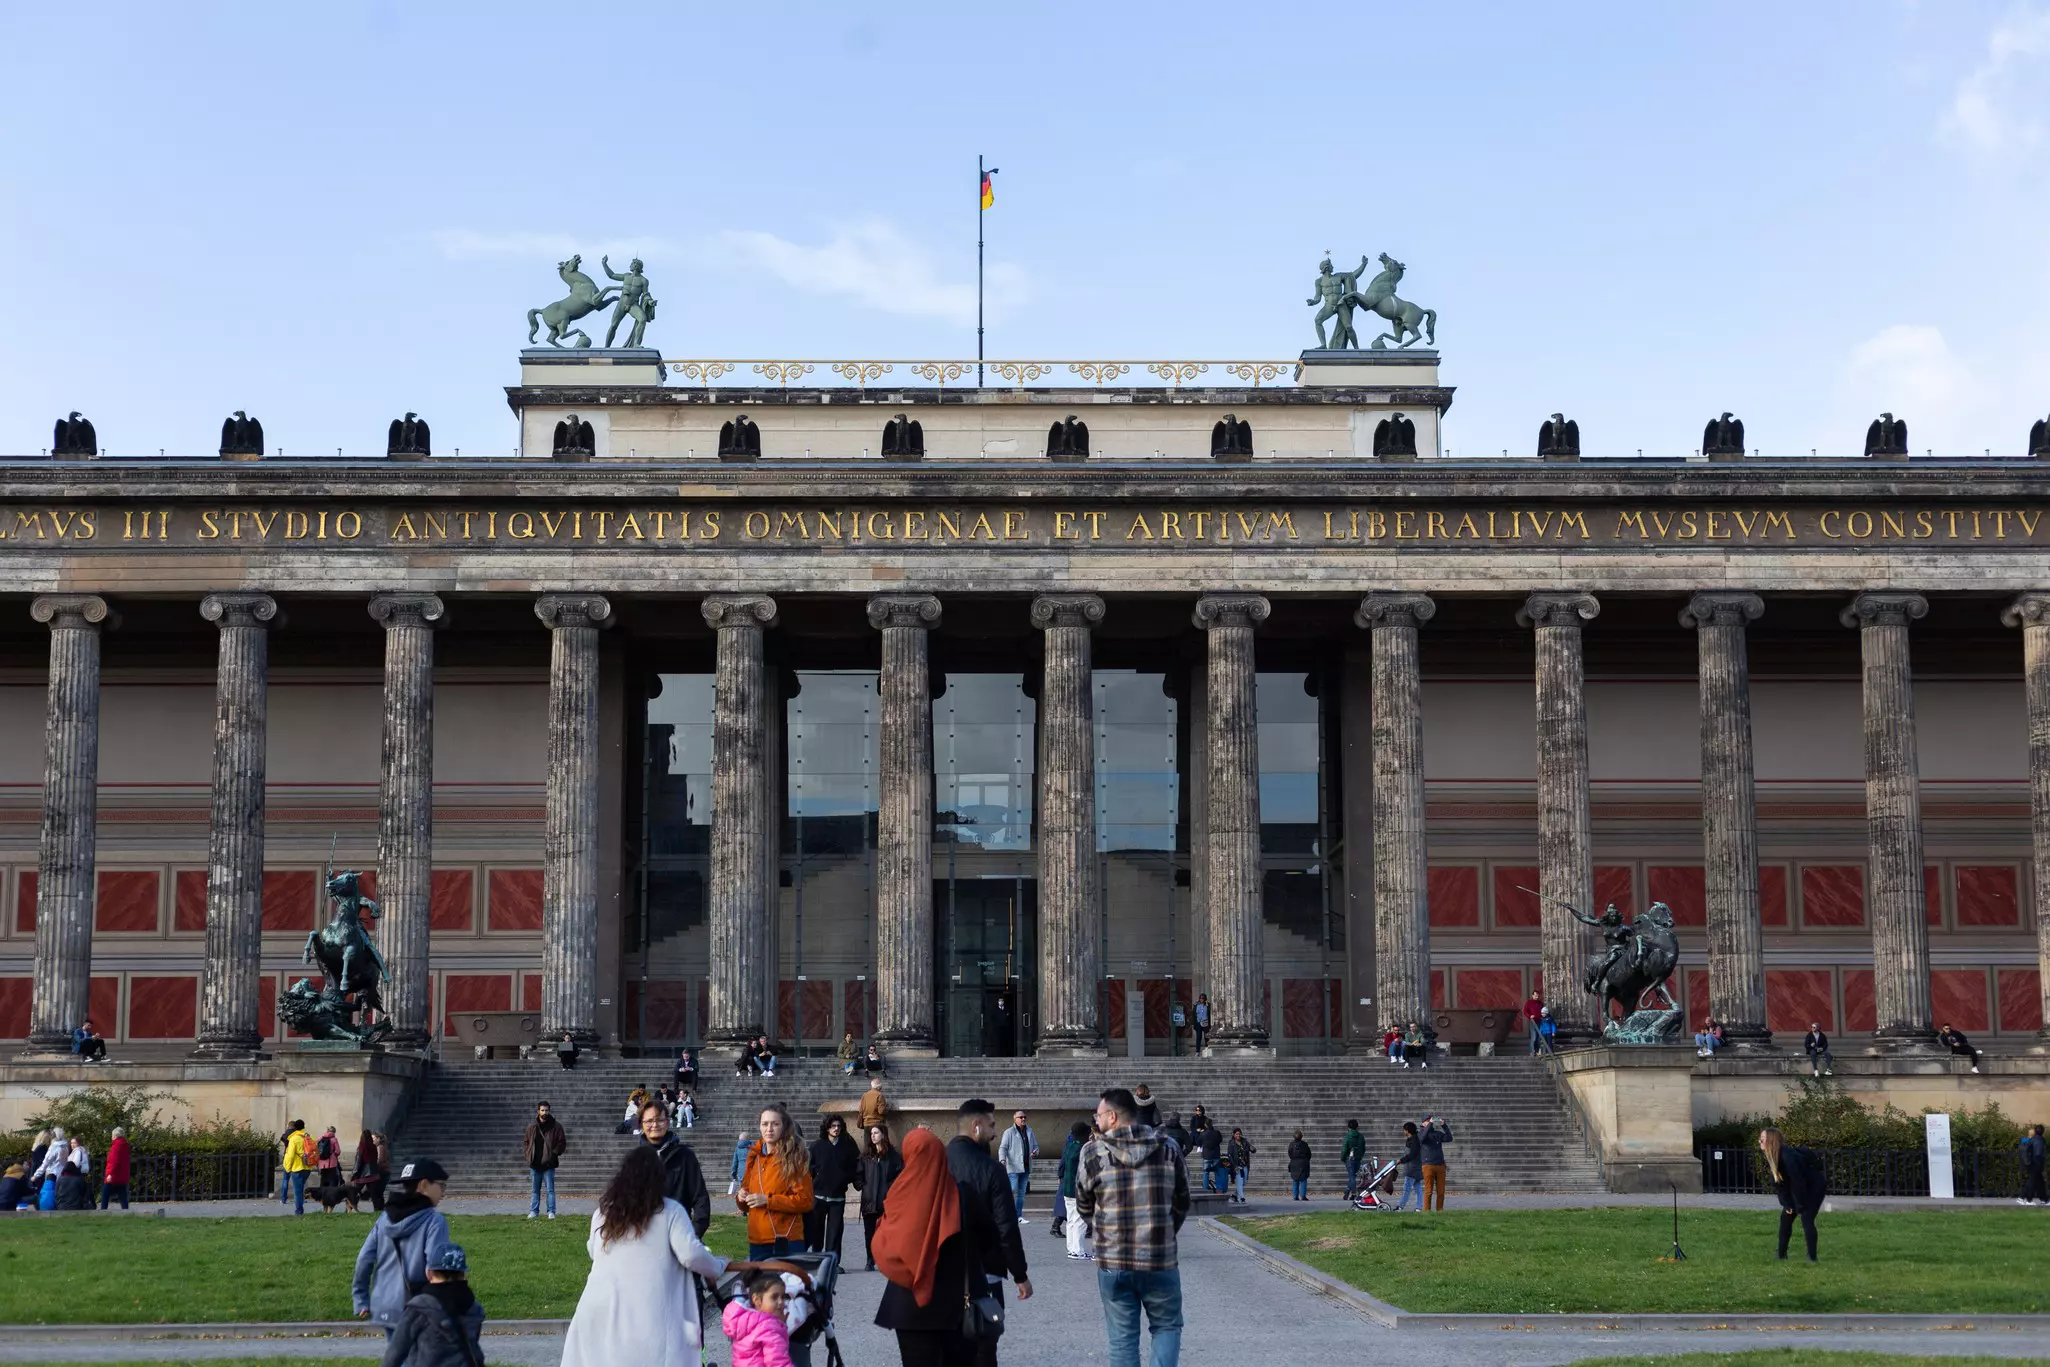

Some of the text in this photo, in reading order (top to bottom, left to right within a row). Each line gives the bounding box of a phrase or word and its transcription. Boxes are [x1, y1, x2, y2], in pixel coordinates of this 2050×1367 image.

[123, 511, 169, 539] III
[198, 511, 362, 539] STVDIO
[391, 511, 720, 539] ANTIQVITATIS
[745, 511, 1029, 539] OMNIGENAE
[1053, 511, 1107, 539] ET
[1126, 511, 1298, 539] ARTIVM
[1323, 511, 1590, 539] LIBERALIVM
[1614, 511, 1796, 539] MVSEVM
[1819, 511, 2043, 539] CONSTITV
